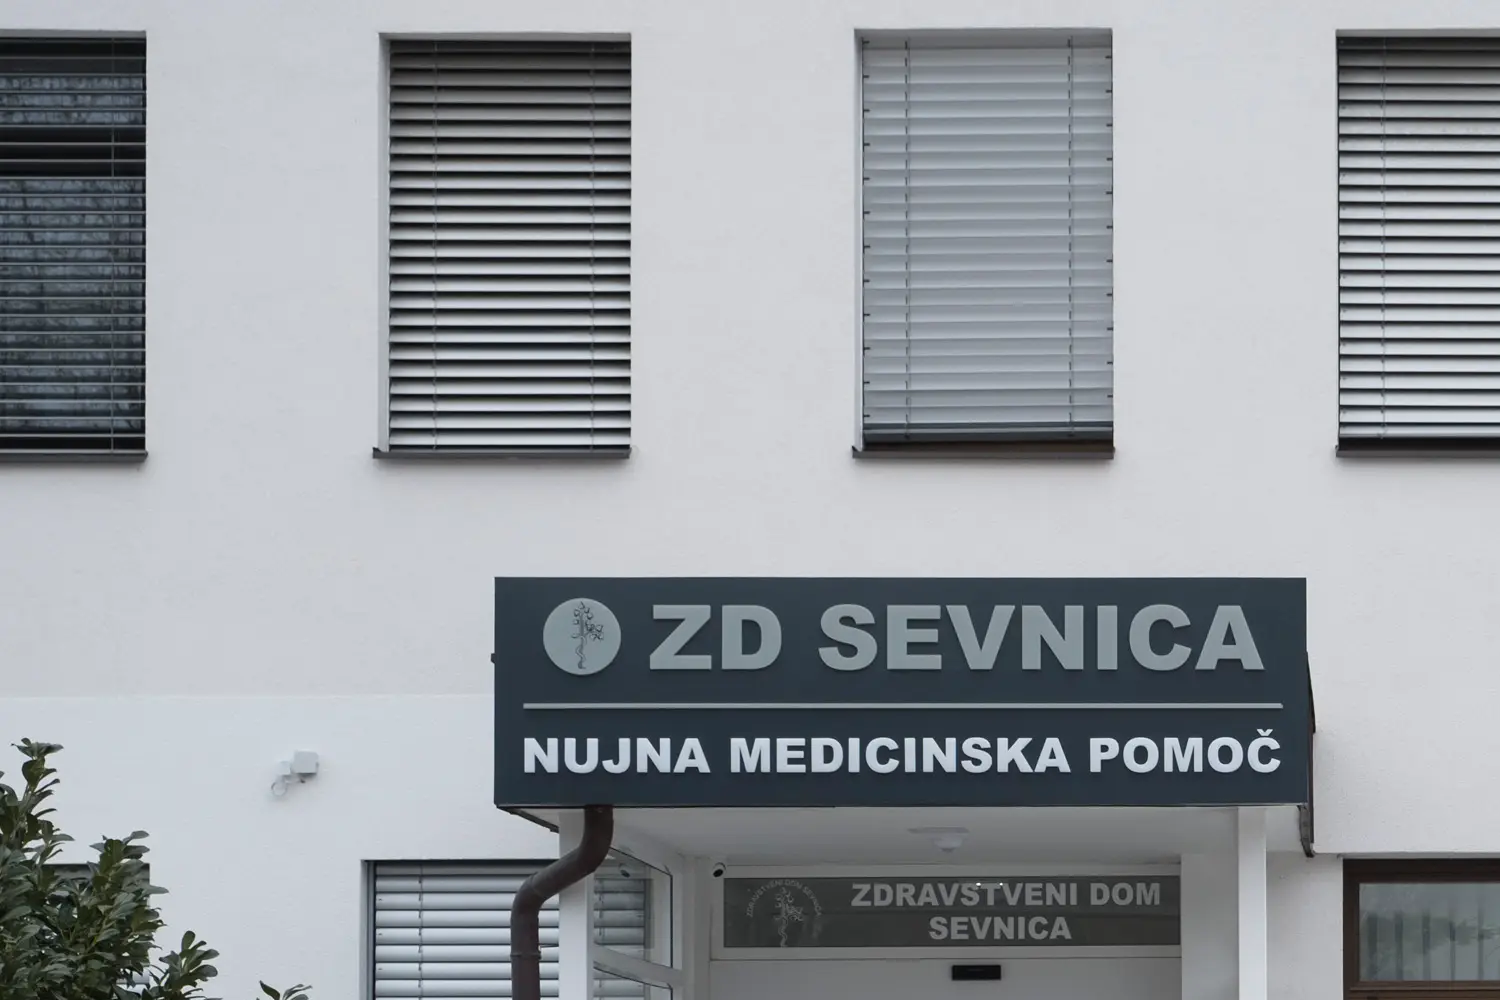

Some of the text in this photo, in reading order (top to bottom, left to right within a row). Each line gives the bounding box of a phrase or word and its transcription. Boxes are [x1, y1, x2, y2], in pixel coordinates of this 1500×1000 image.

[650, 604, 1265, 671] ZD SEVNICA
[523, 728, 1281, 774] NUJNA MEDICINSKA POMOČ
[851, 882, 1161, 907] ZDRAVSTVENI DOM
[929, 916, 1072, 940] SEVNICA
